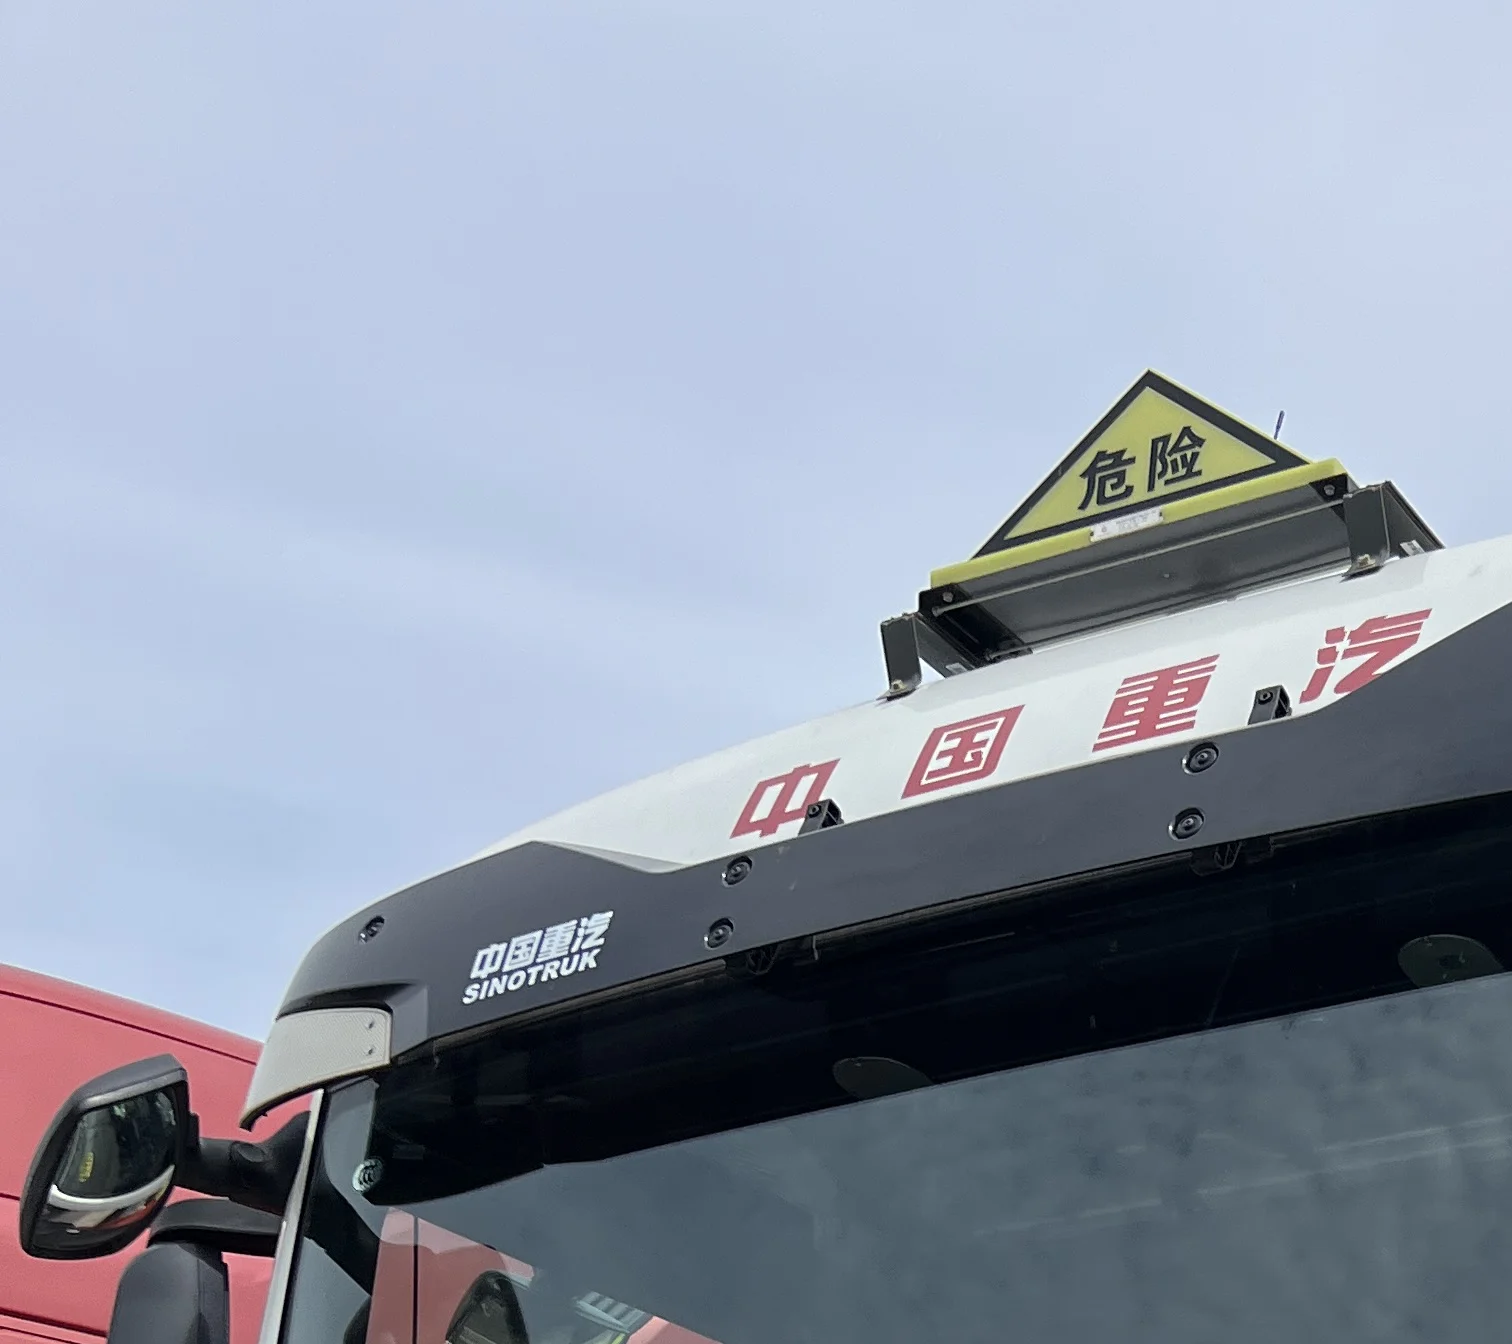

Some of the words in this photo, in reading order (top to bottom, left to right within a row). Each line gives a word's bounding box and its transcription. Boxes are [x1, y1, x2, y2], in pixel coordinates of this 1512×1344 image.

[1078, 426, 1206, 510] 危险
[730, 608, 1432, 838] 中国重汽
[462, 948, 601, 1004] SINOTRUK
[470, 911, 613, 979] 中国重汽
